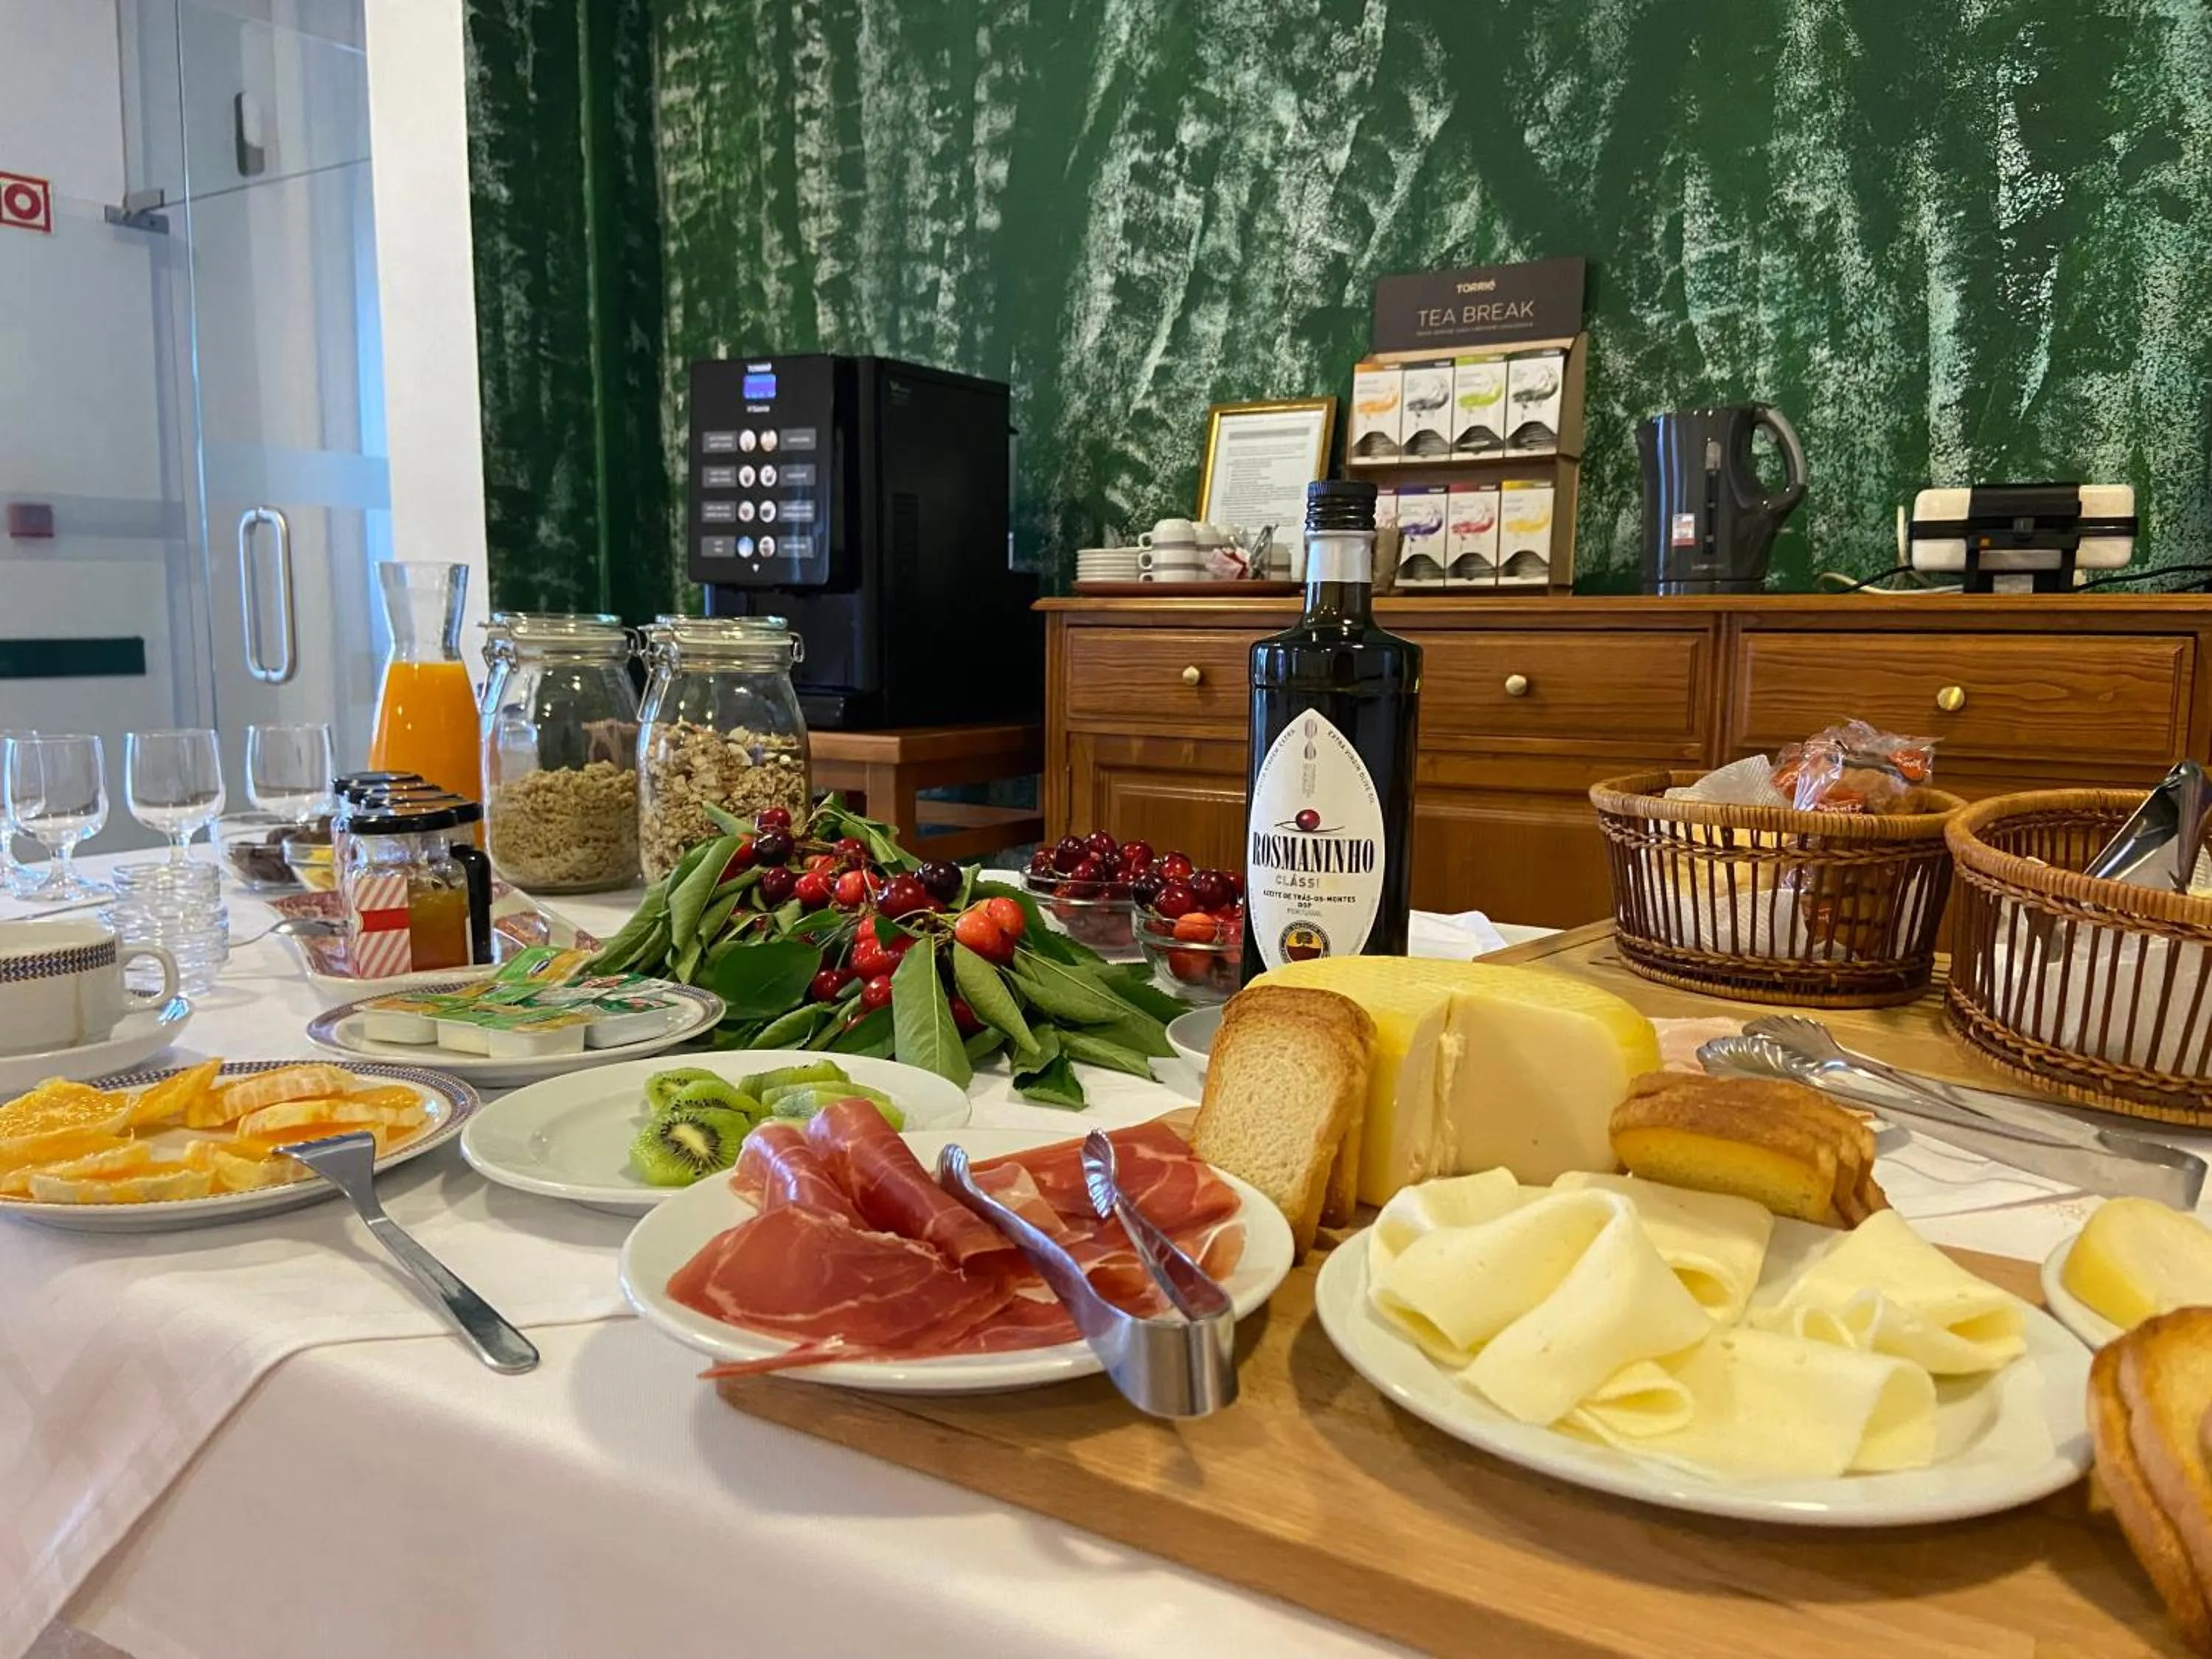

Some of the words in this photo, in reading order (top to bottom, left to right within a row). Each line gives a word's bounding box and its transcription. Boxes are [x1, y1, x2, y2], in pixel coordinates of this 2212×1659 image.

[1417, 308, 1456, 327] TEA
[1462, 300, 1534, 324] BREAK
[1253, 832, 1374, 873] ROSMANINHO
